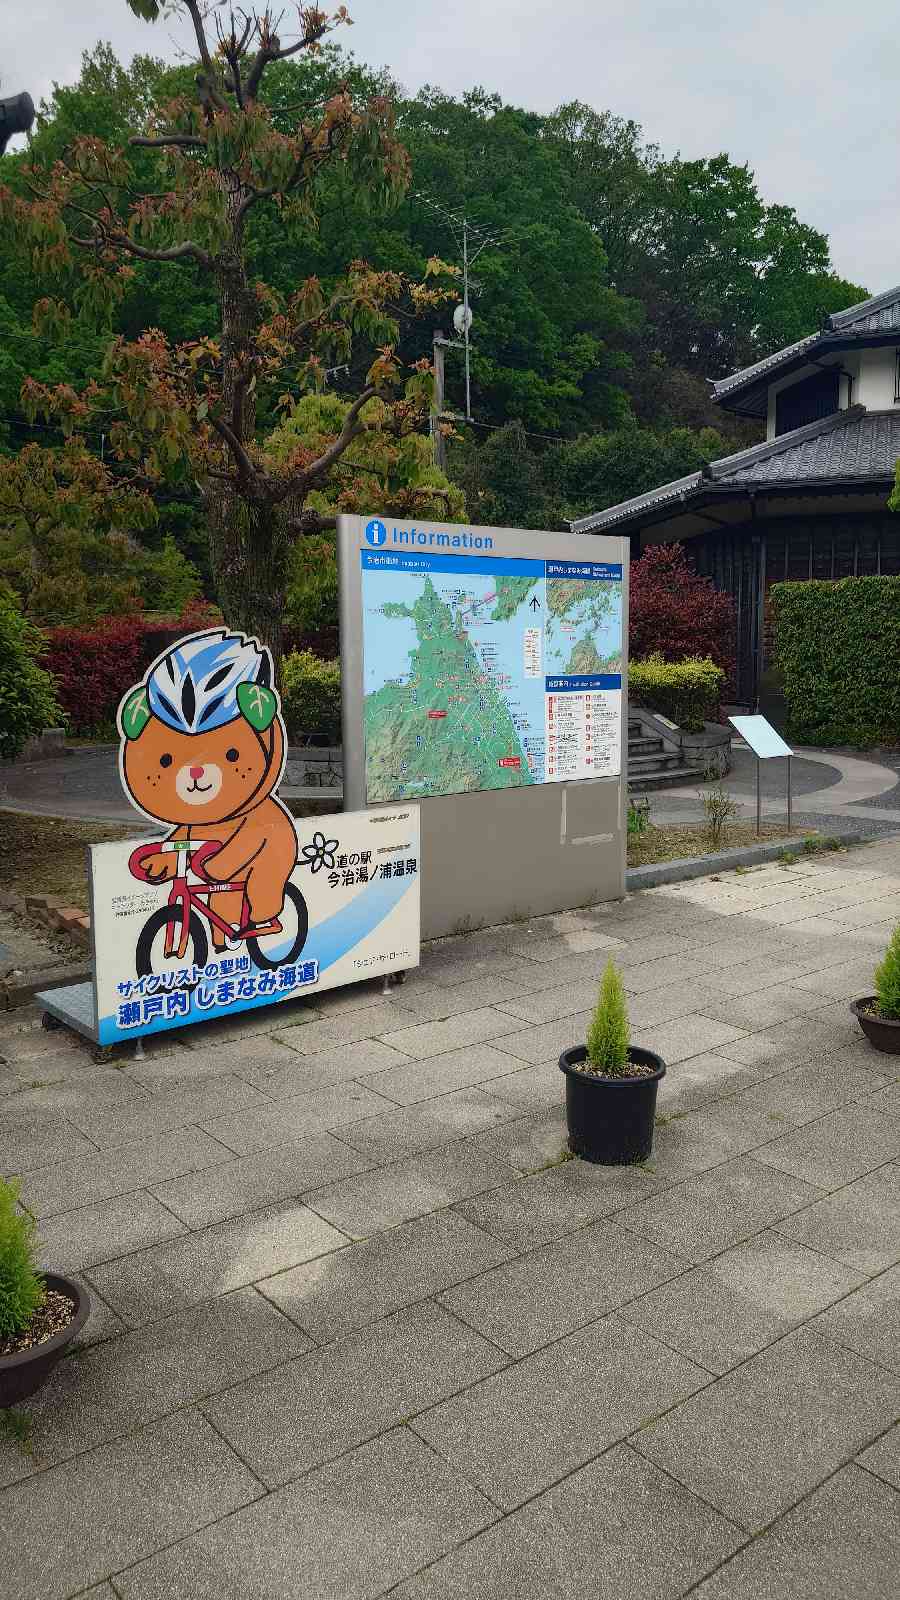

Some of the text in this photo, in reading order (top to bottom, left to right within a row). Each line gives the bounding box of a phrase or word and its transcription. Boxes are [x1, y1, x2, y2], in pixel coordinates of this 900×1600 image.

[393, 528, 493, 549] Information
[327, 858, 418, 888] 今治湯ノ浦温泉
[336, 851, 372, 869] 道の駅
[116, 956, 250, 998] サイクリストの聖地
[118, 961, 317, 1026] 瀬戸内 しまなみ海道
